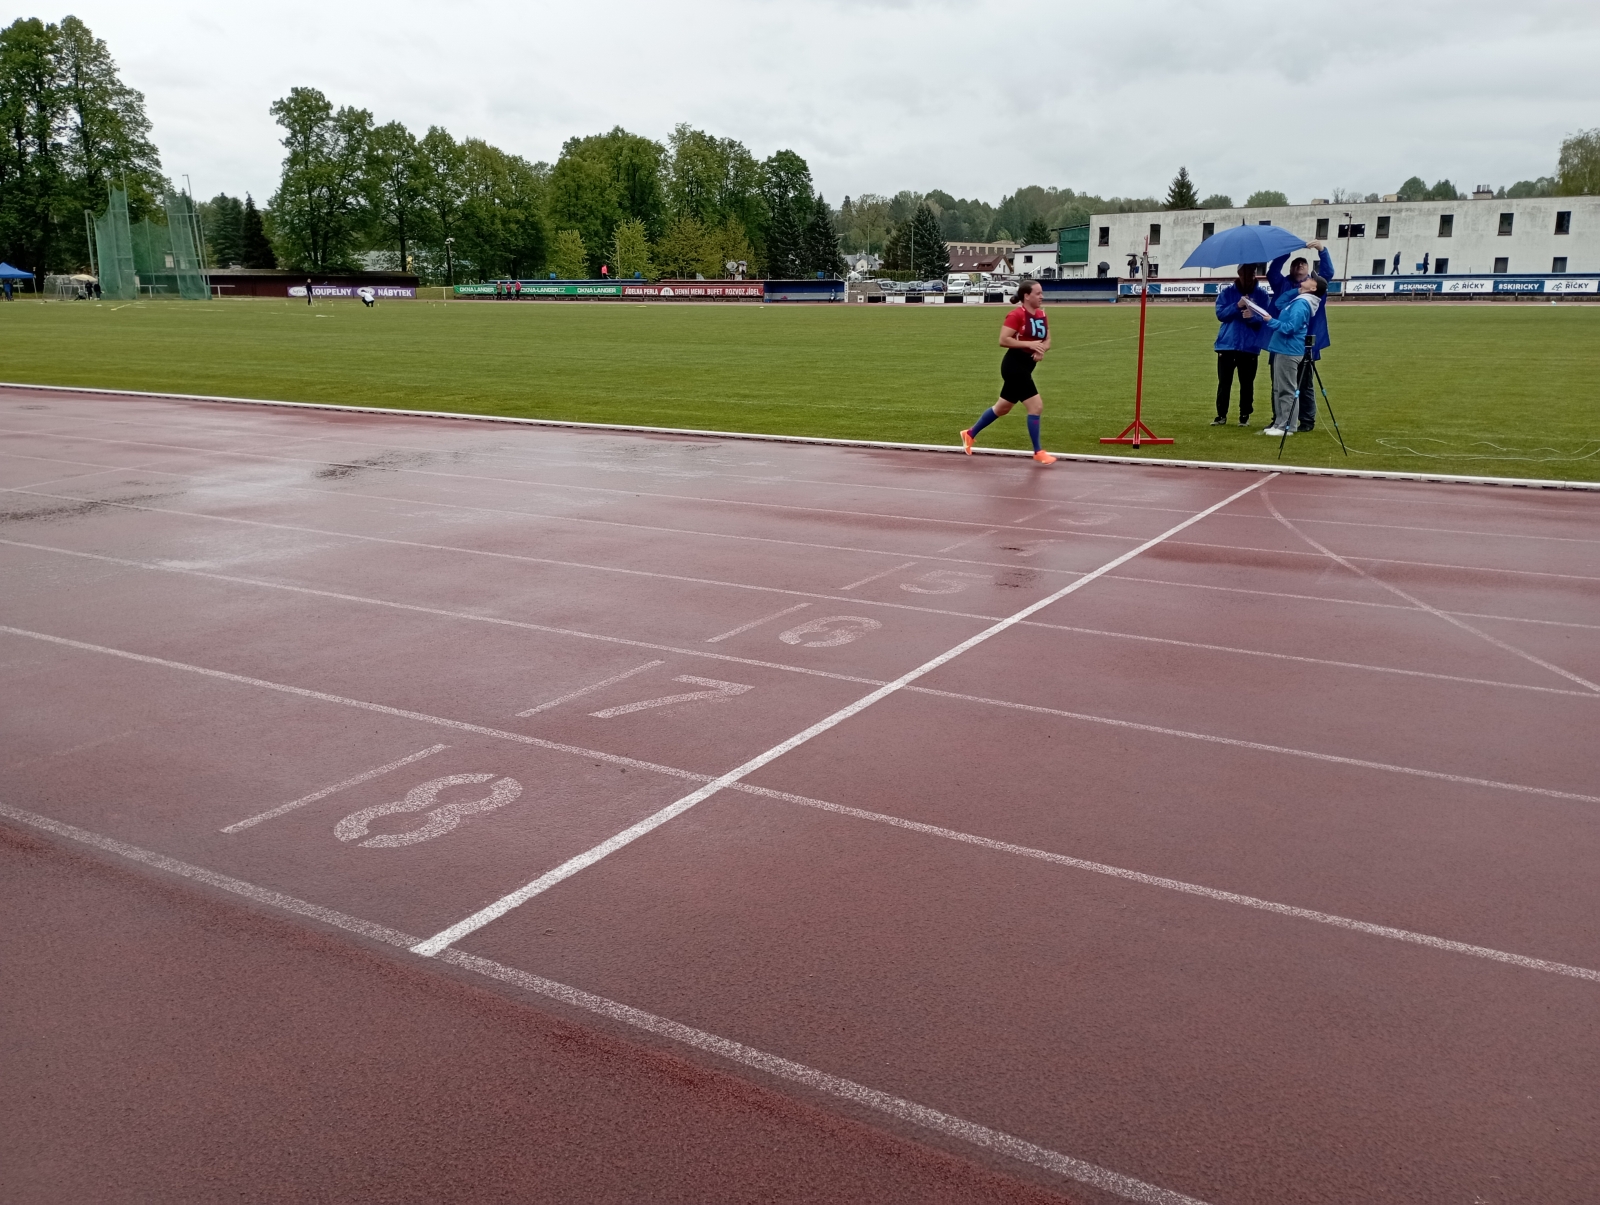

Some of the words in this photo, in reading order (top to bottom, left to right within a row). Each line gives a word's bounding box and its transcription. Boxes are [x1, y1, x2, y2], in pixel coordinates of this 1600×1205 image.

[378, 287, 412, 297] NÁBYTEK
[625, 286, 643, 295] JÍDELNA
[643, 287, 659, 295] PERLA
[674, 286, 690, 295] DENNÍ
[725, 287, 745, 296] ROZVOZ
[1029, 317, 1046, 339] 15
[899, 569, 994, 595] 5
[778, 614, 883, 648] 6
[588, 674, 755, 718] 7
[333, 772, 524, 849] 8
